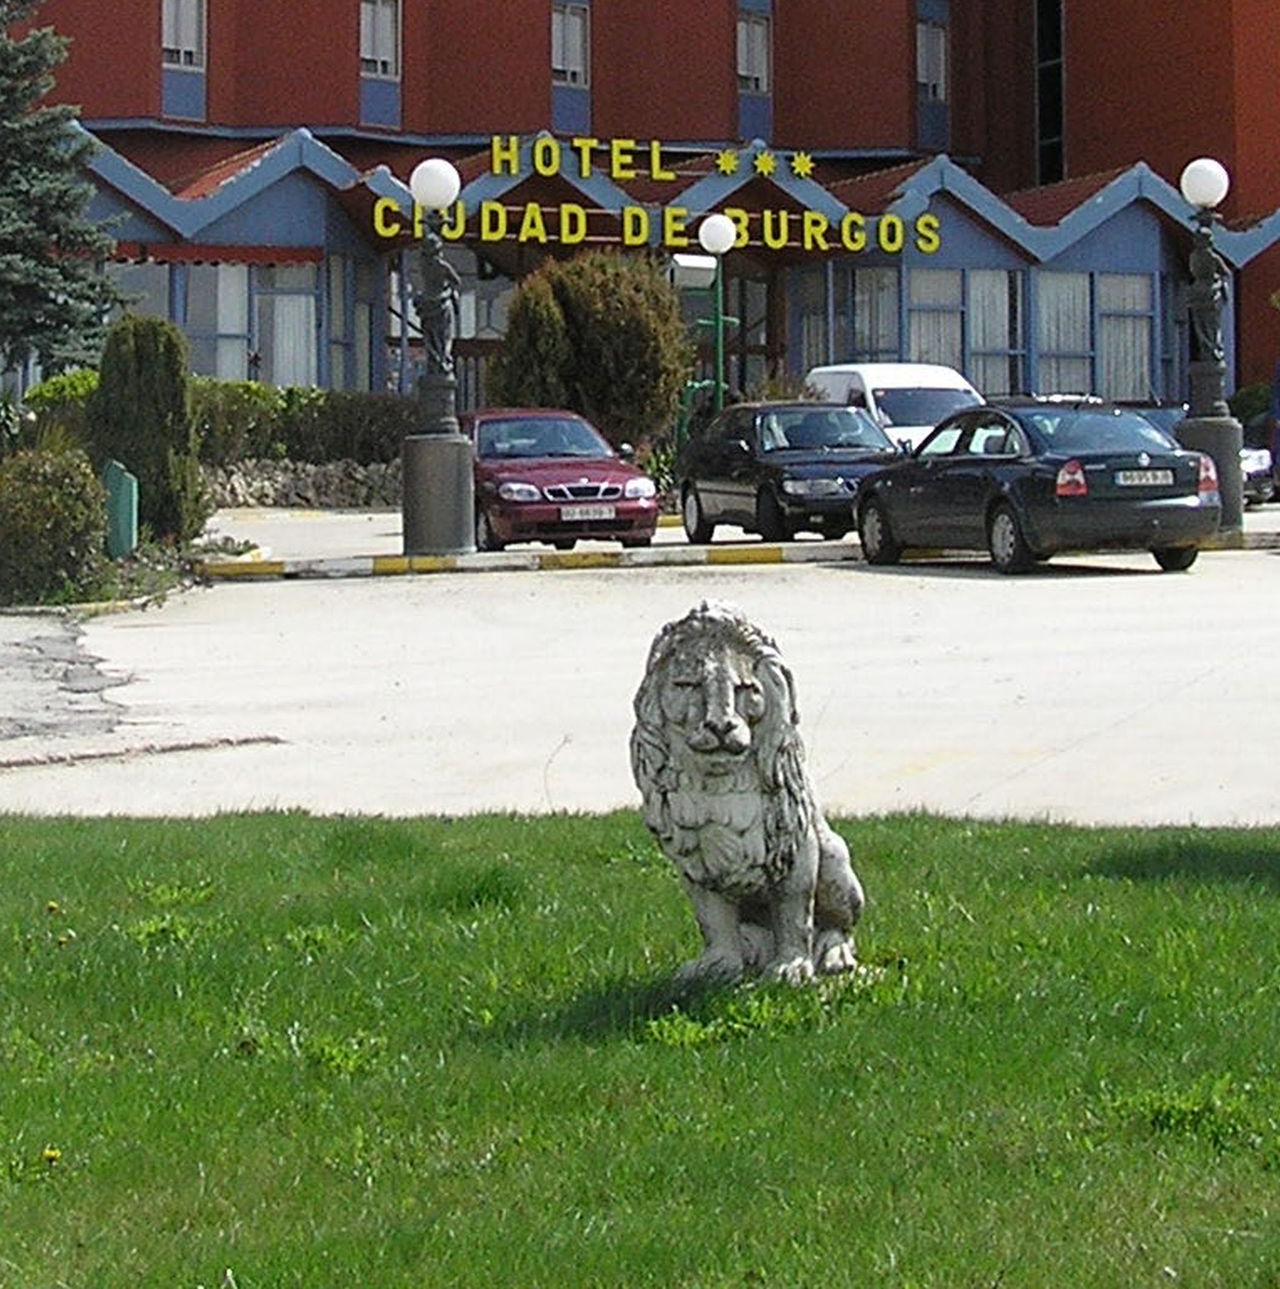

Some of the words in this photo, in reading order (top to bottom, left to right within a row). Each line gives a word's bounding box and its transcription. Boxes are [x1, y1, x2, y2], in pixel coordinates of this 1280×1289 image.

[491, 134, 677, 181] HOTEL
[374, 196, 587, 246] CIUDAD
[623, 206, 689, 247] DE
[723, 207, 941, 253] BURGOS
